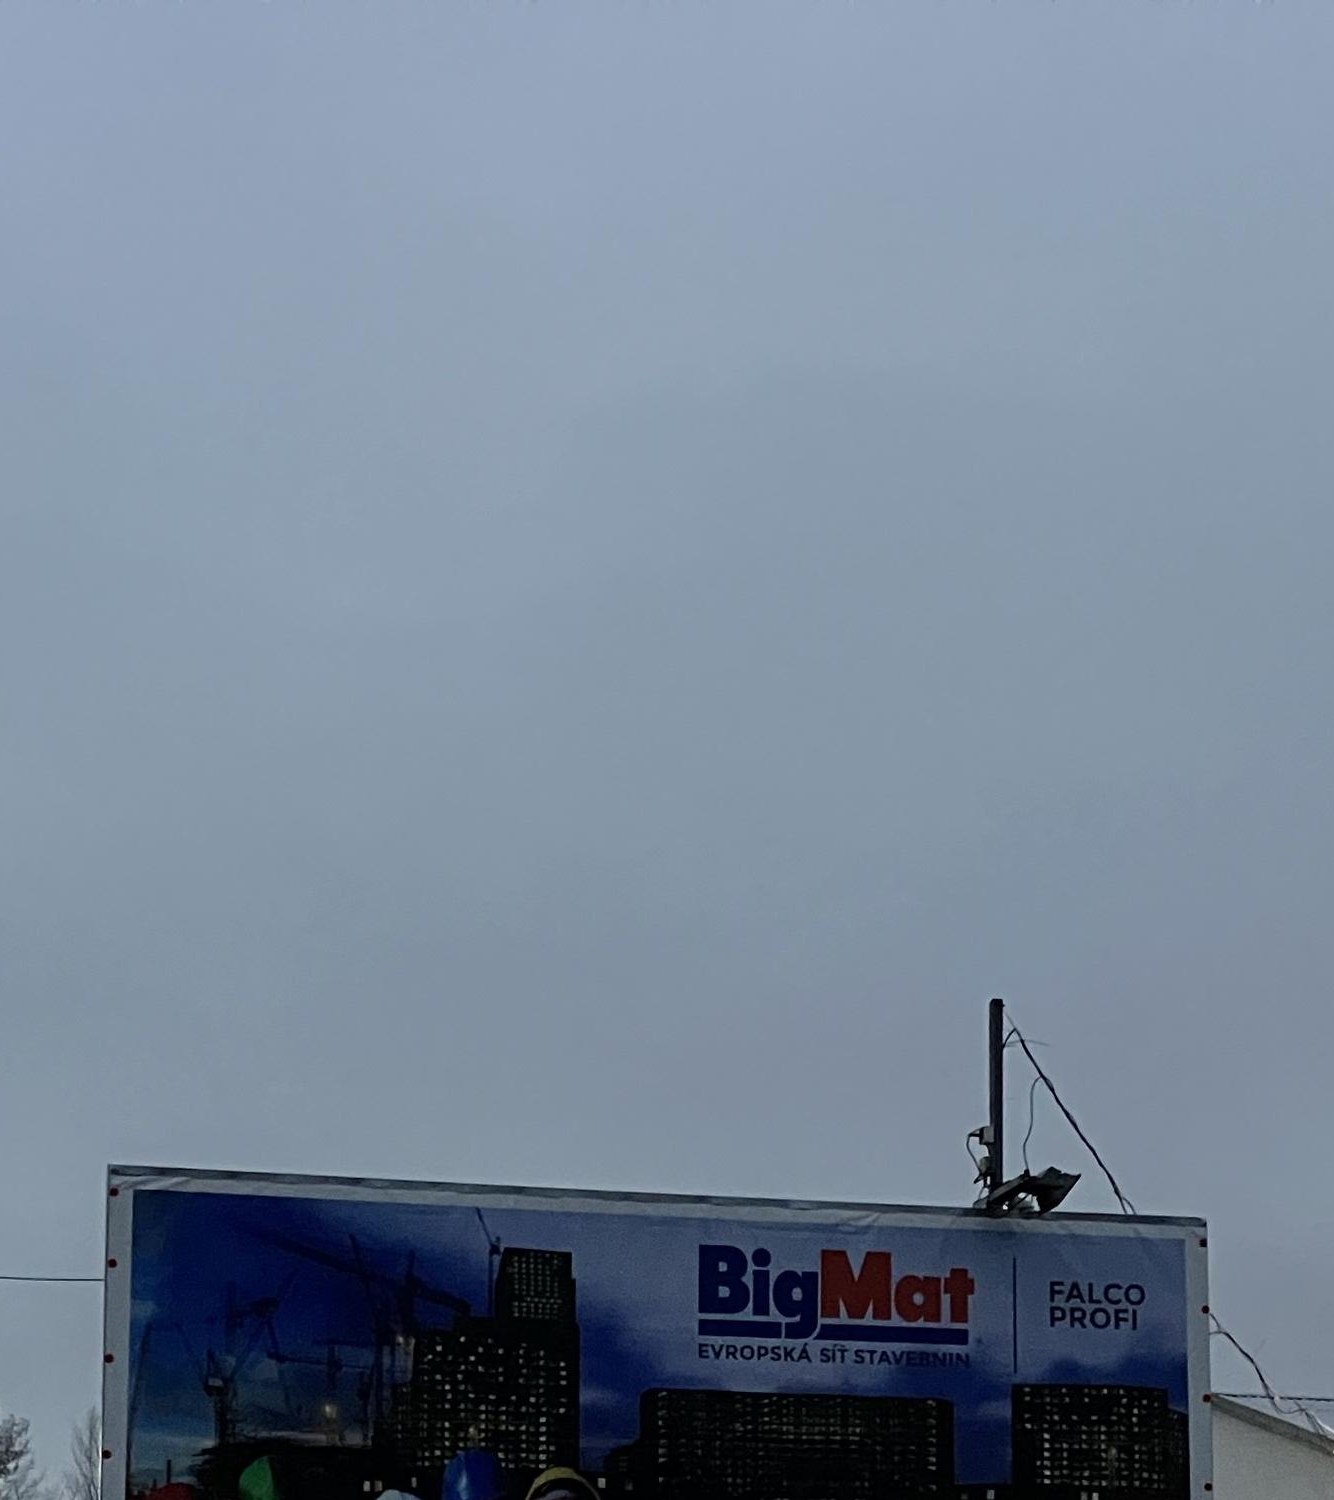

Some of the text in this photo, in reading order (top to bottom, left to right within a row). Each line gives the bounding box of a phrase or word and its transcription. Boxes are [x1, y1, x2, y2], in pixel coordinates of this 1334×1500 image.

[698, 1244, 975, 1340] BigMat
[1048, 1280, 1146, 1307] FALCO
[1048, 1306, 1140, 1331] PROFI
[697, 1342, 812, 1364] EVROPSKÁ
[854, 1348, 970, 1369] STAVEBNIN
